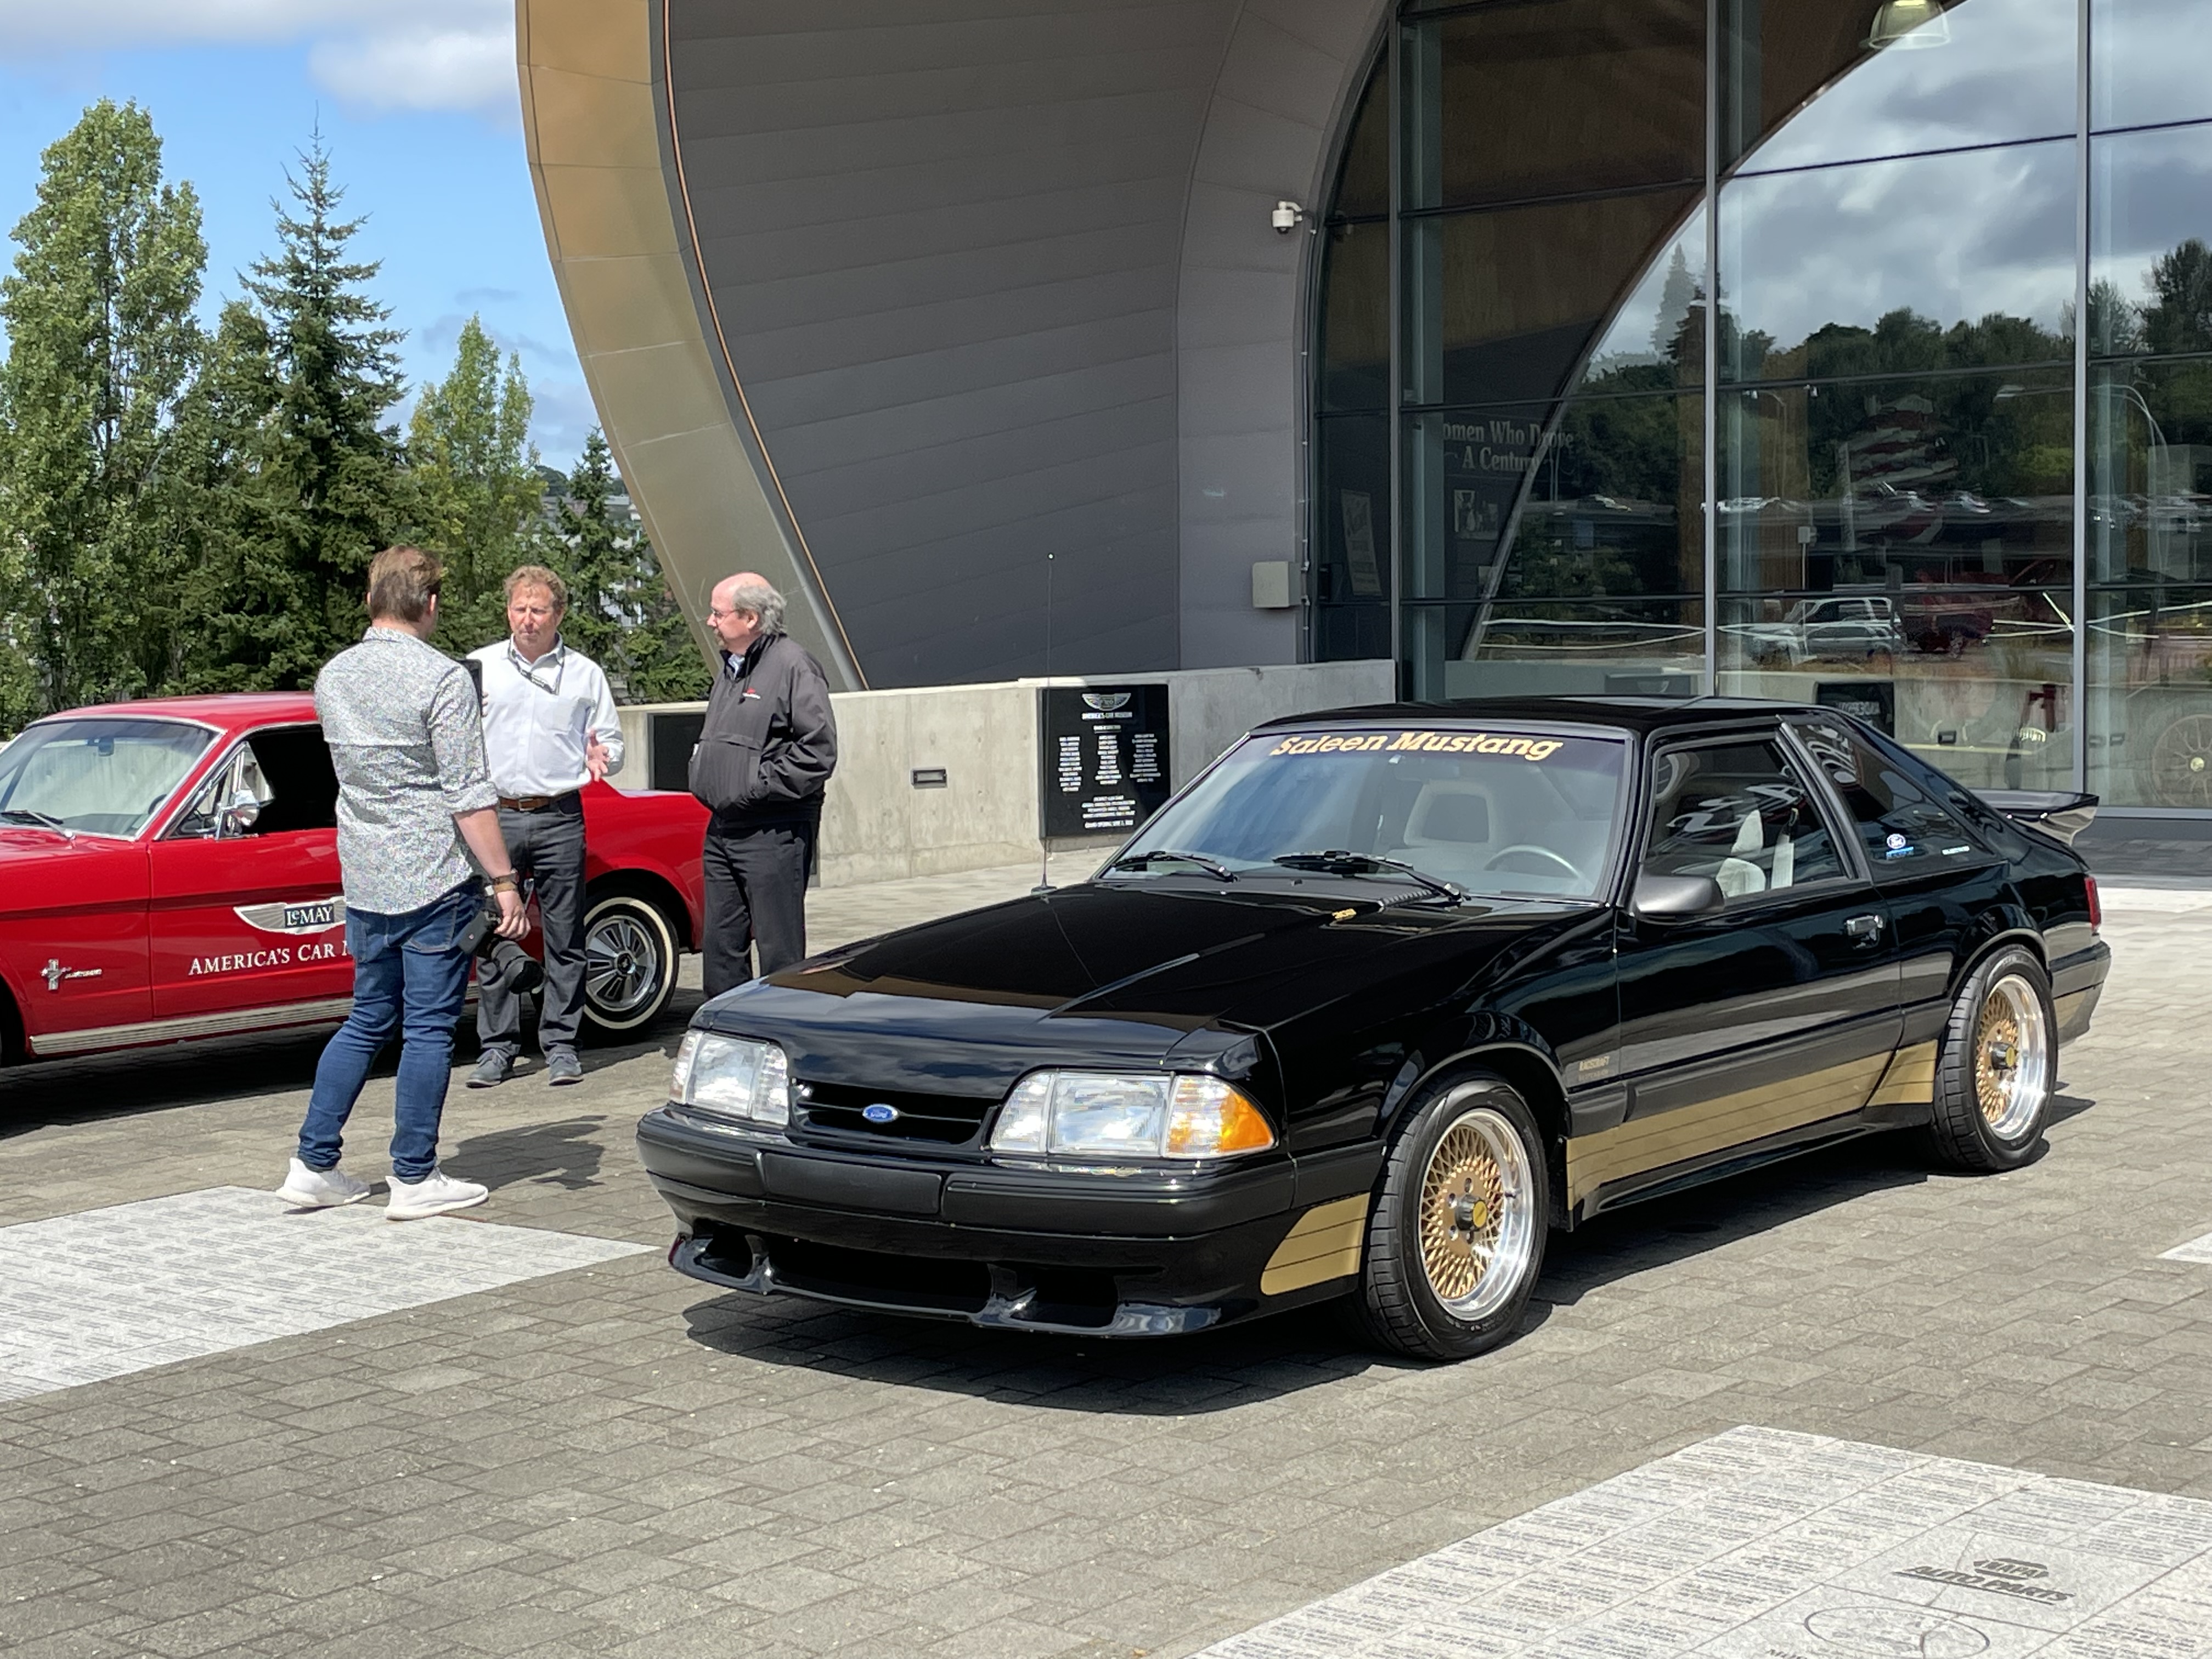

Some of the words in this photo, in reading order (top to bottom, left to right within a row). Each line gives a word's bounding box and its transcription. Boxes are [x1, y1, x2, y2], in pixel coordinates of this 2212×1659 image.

[1443, 423, 1484, 442] omen
[1489, 420, 1525, 445] Who
[1463, 445, 1474, 469] A
[1268, 735, 1388, 756] Saleen
[1386, 732, 1564, 761] Mustang
[286, 906, 332, 926] LeMAY
[188, 948, 290, 975] AMERICA'S
[298, 943, 336, 961] CAR
[1982, 1561, 2045, 1578] NAPA
[1901, 1566, 1986, 1583] AUTO
[1982, 1579, 2075, 1601] PARTS
